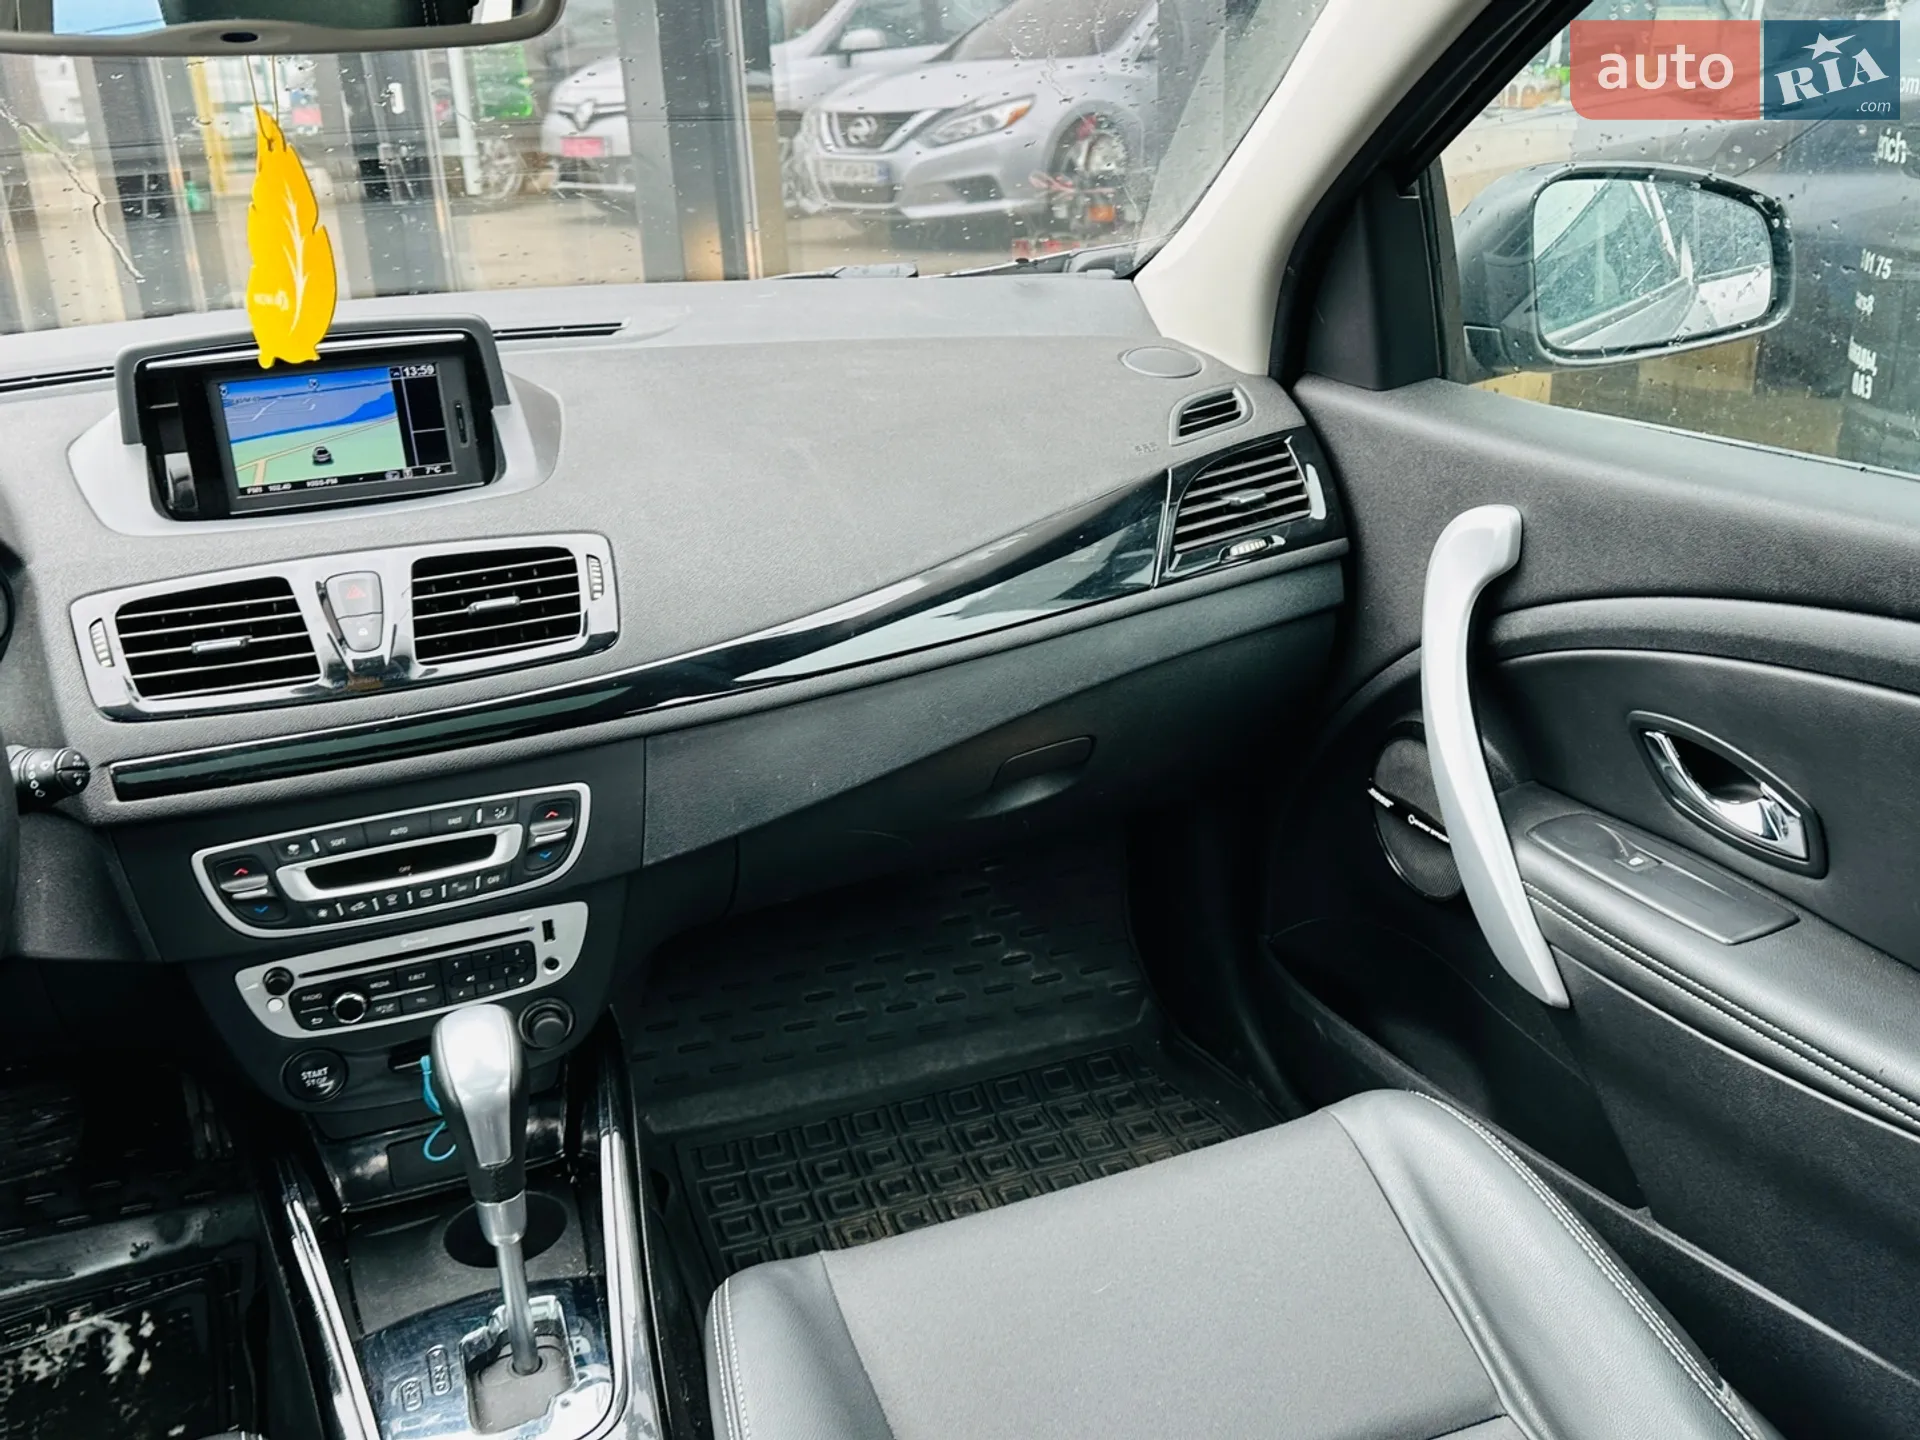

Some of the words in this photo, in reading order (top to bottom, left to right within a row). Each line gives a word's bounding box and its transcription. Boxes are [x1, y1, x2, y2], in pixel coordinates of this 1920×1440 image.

[403, 365, 435, 377] 13:59
[390, 826, 409, 837] AUTO
[301, 1066, 329, 1081] START
[305, 1076, 328, 1088] STOP
